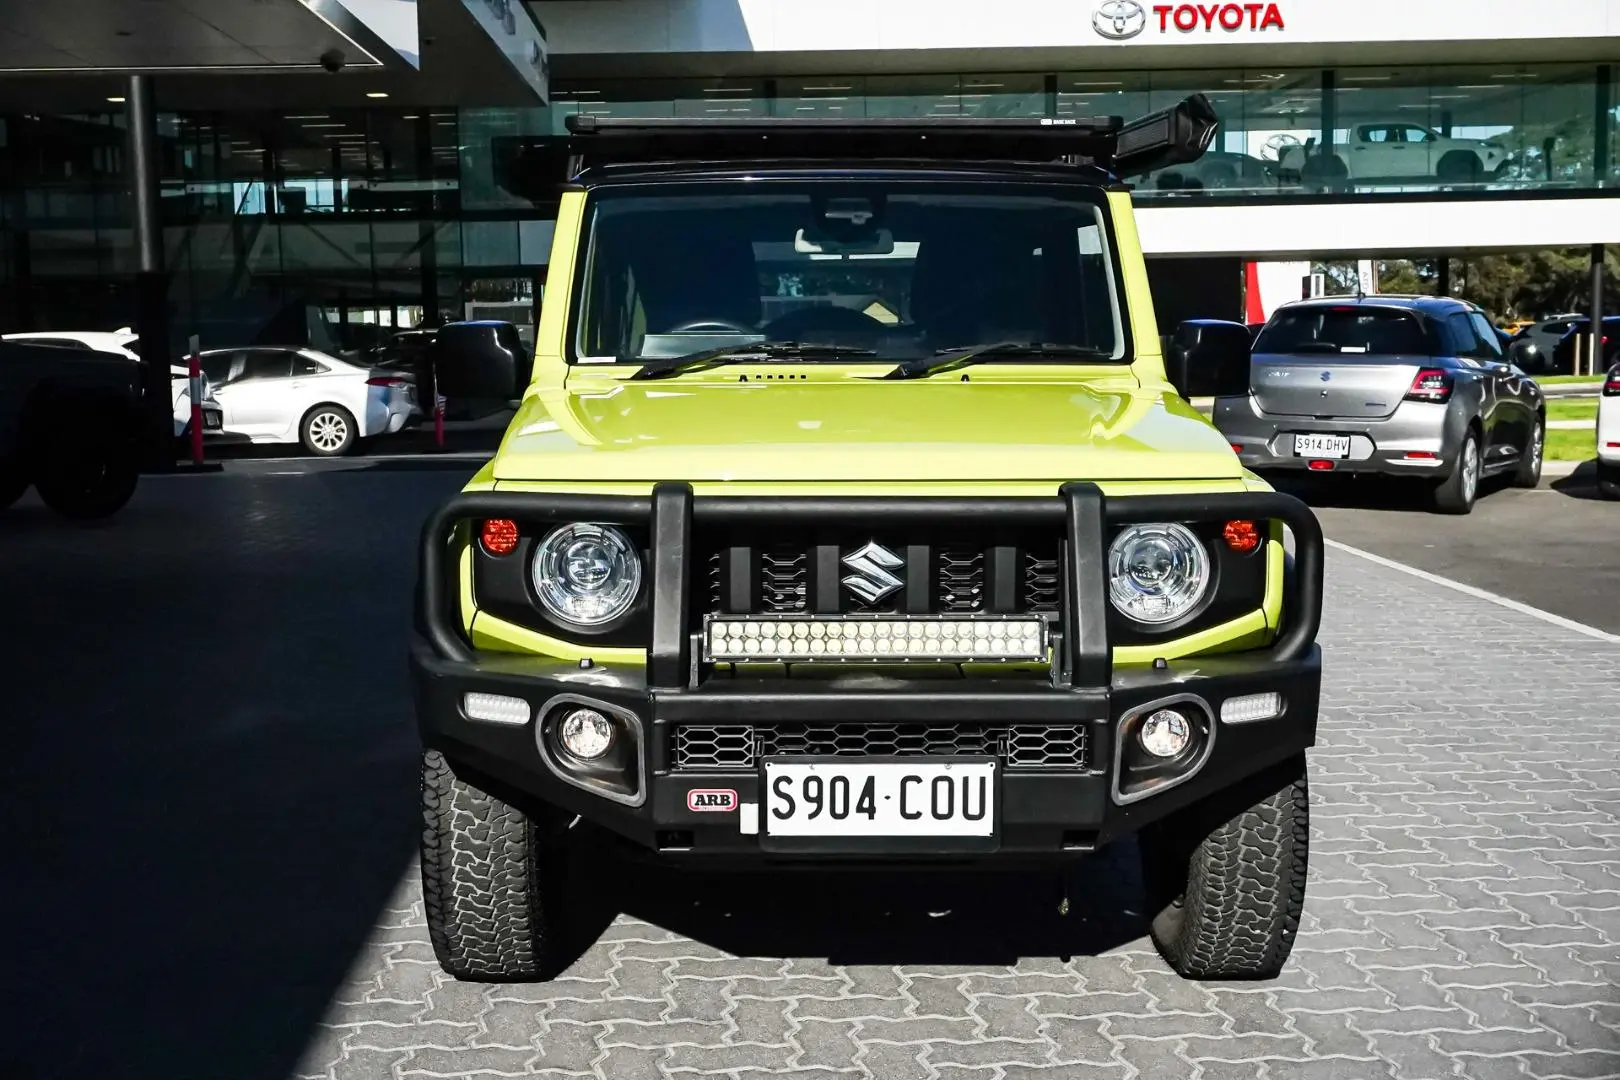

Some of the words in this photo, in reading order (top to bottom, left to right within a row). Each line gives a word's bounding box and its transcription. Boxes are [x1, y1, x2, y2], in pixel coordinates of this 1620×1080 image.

[1153, 3, 1285, 32] TOYOTA
[1297, 438, 1322, 450] S914
[1326, 439, 1348, 451] DHV
[694, 794, 731, 807] ARB
